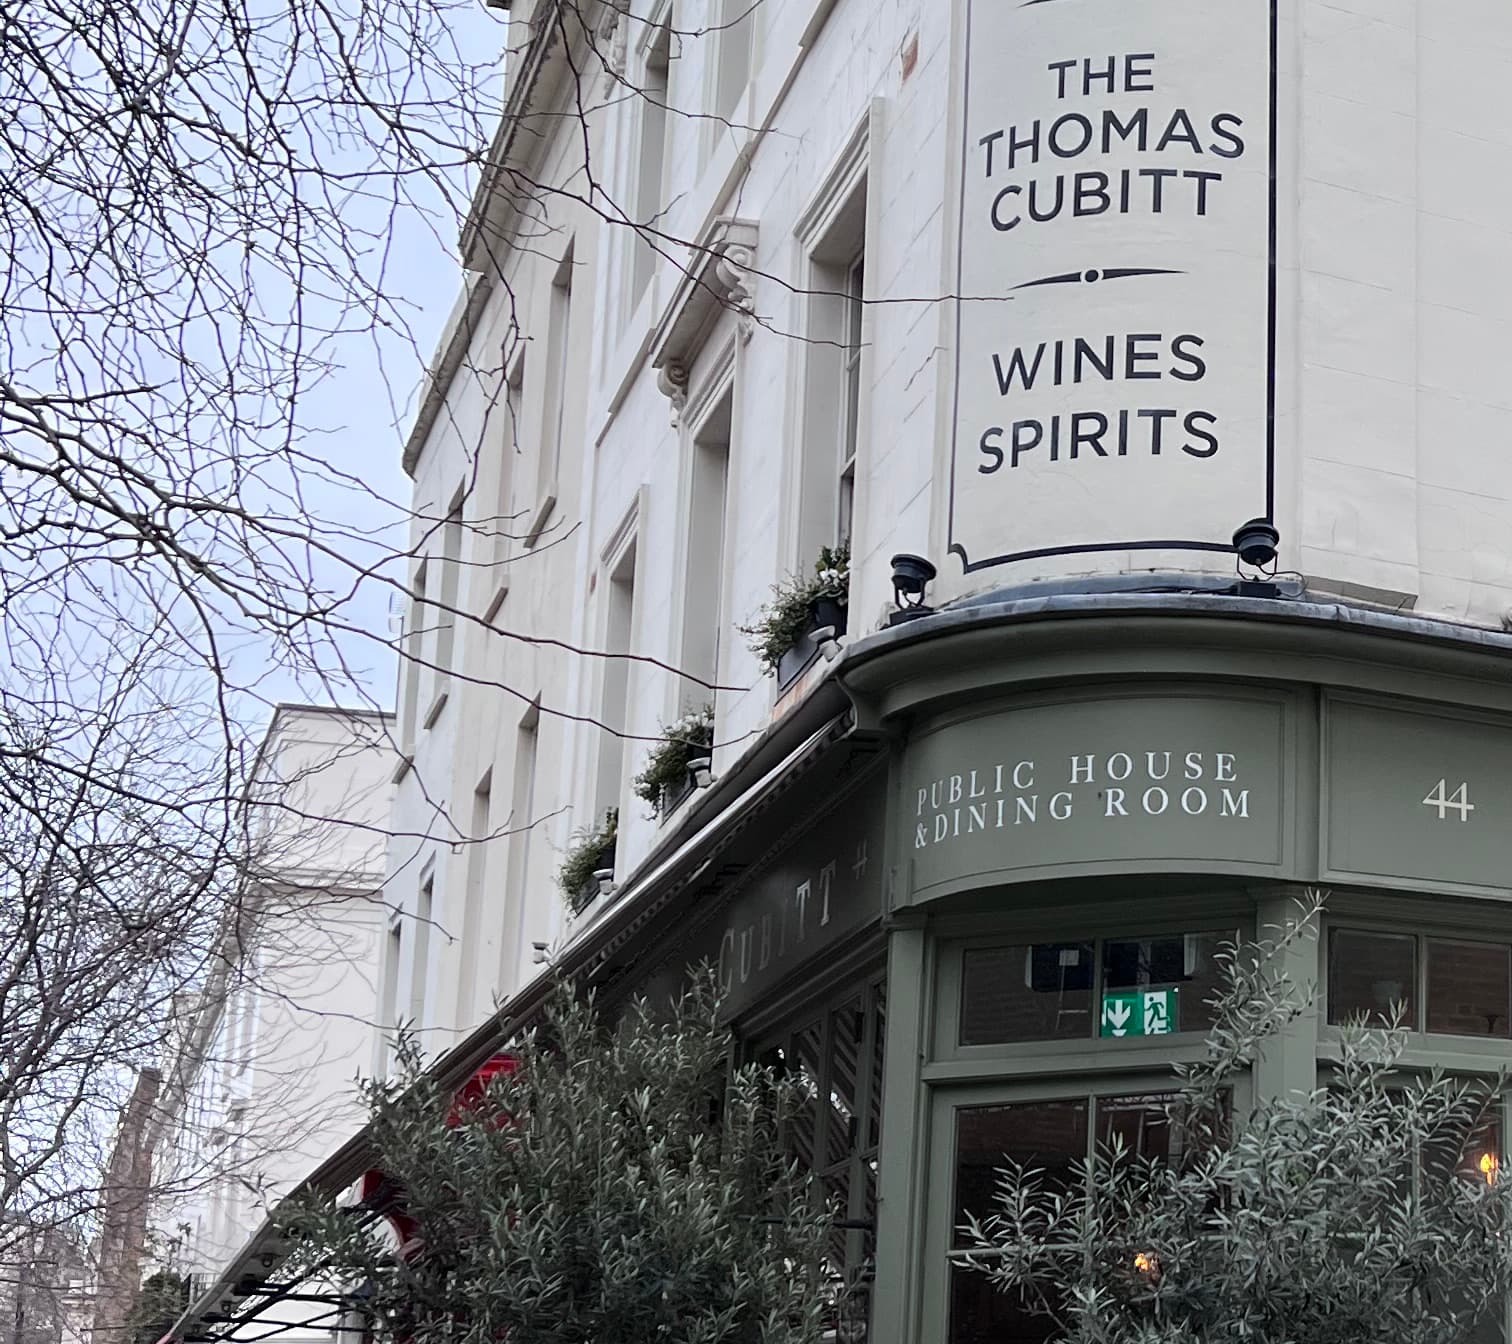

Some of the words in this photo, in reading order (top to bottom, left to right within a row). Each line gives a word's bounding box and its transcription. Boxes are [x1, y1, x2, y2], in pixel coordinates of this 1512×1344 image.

[1047, 53, 1155, 99] THE
[978, 107, 1245, 178] THOMAS
[990, 168, 1223, 232] CUBITT
[991, 334, 1207, 396] WINES
[978, 409, 1219, 475] SPIRITS
[916, 761, 1034, 816] PUBLIC
[1069, 751, 1237, 784] HOUSE
[1104, 786, 1249, 818] ROOM
[1422, 778, 1475, 822] 44
